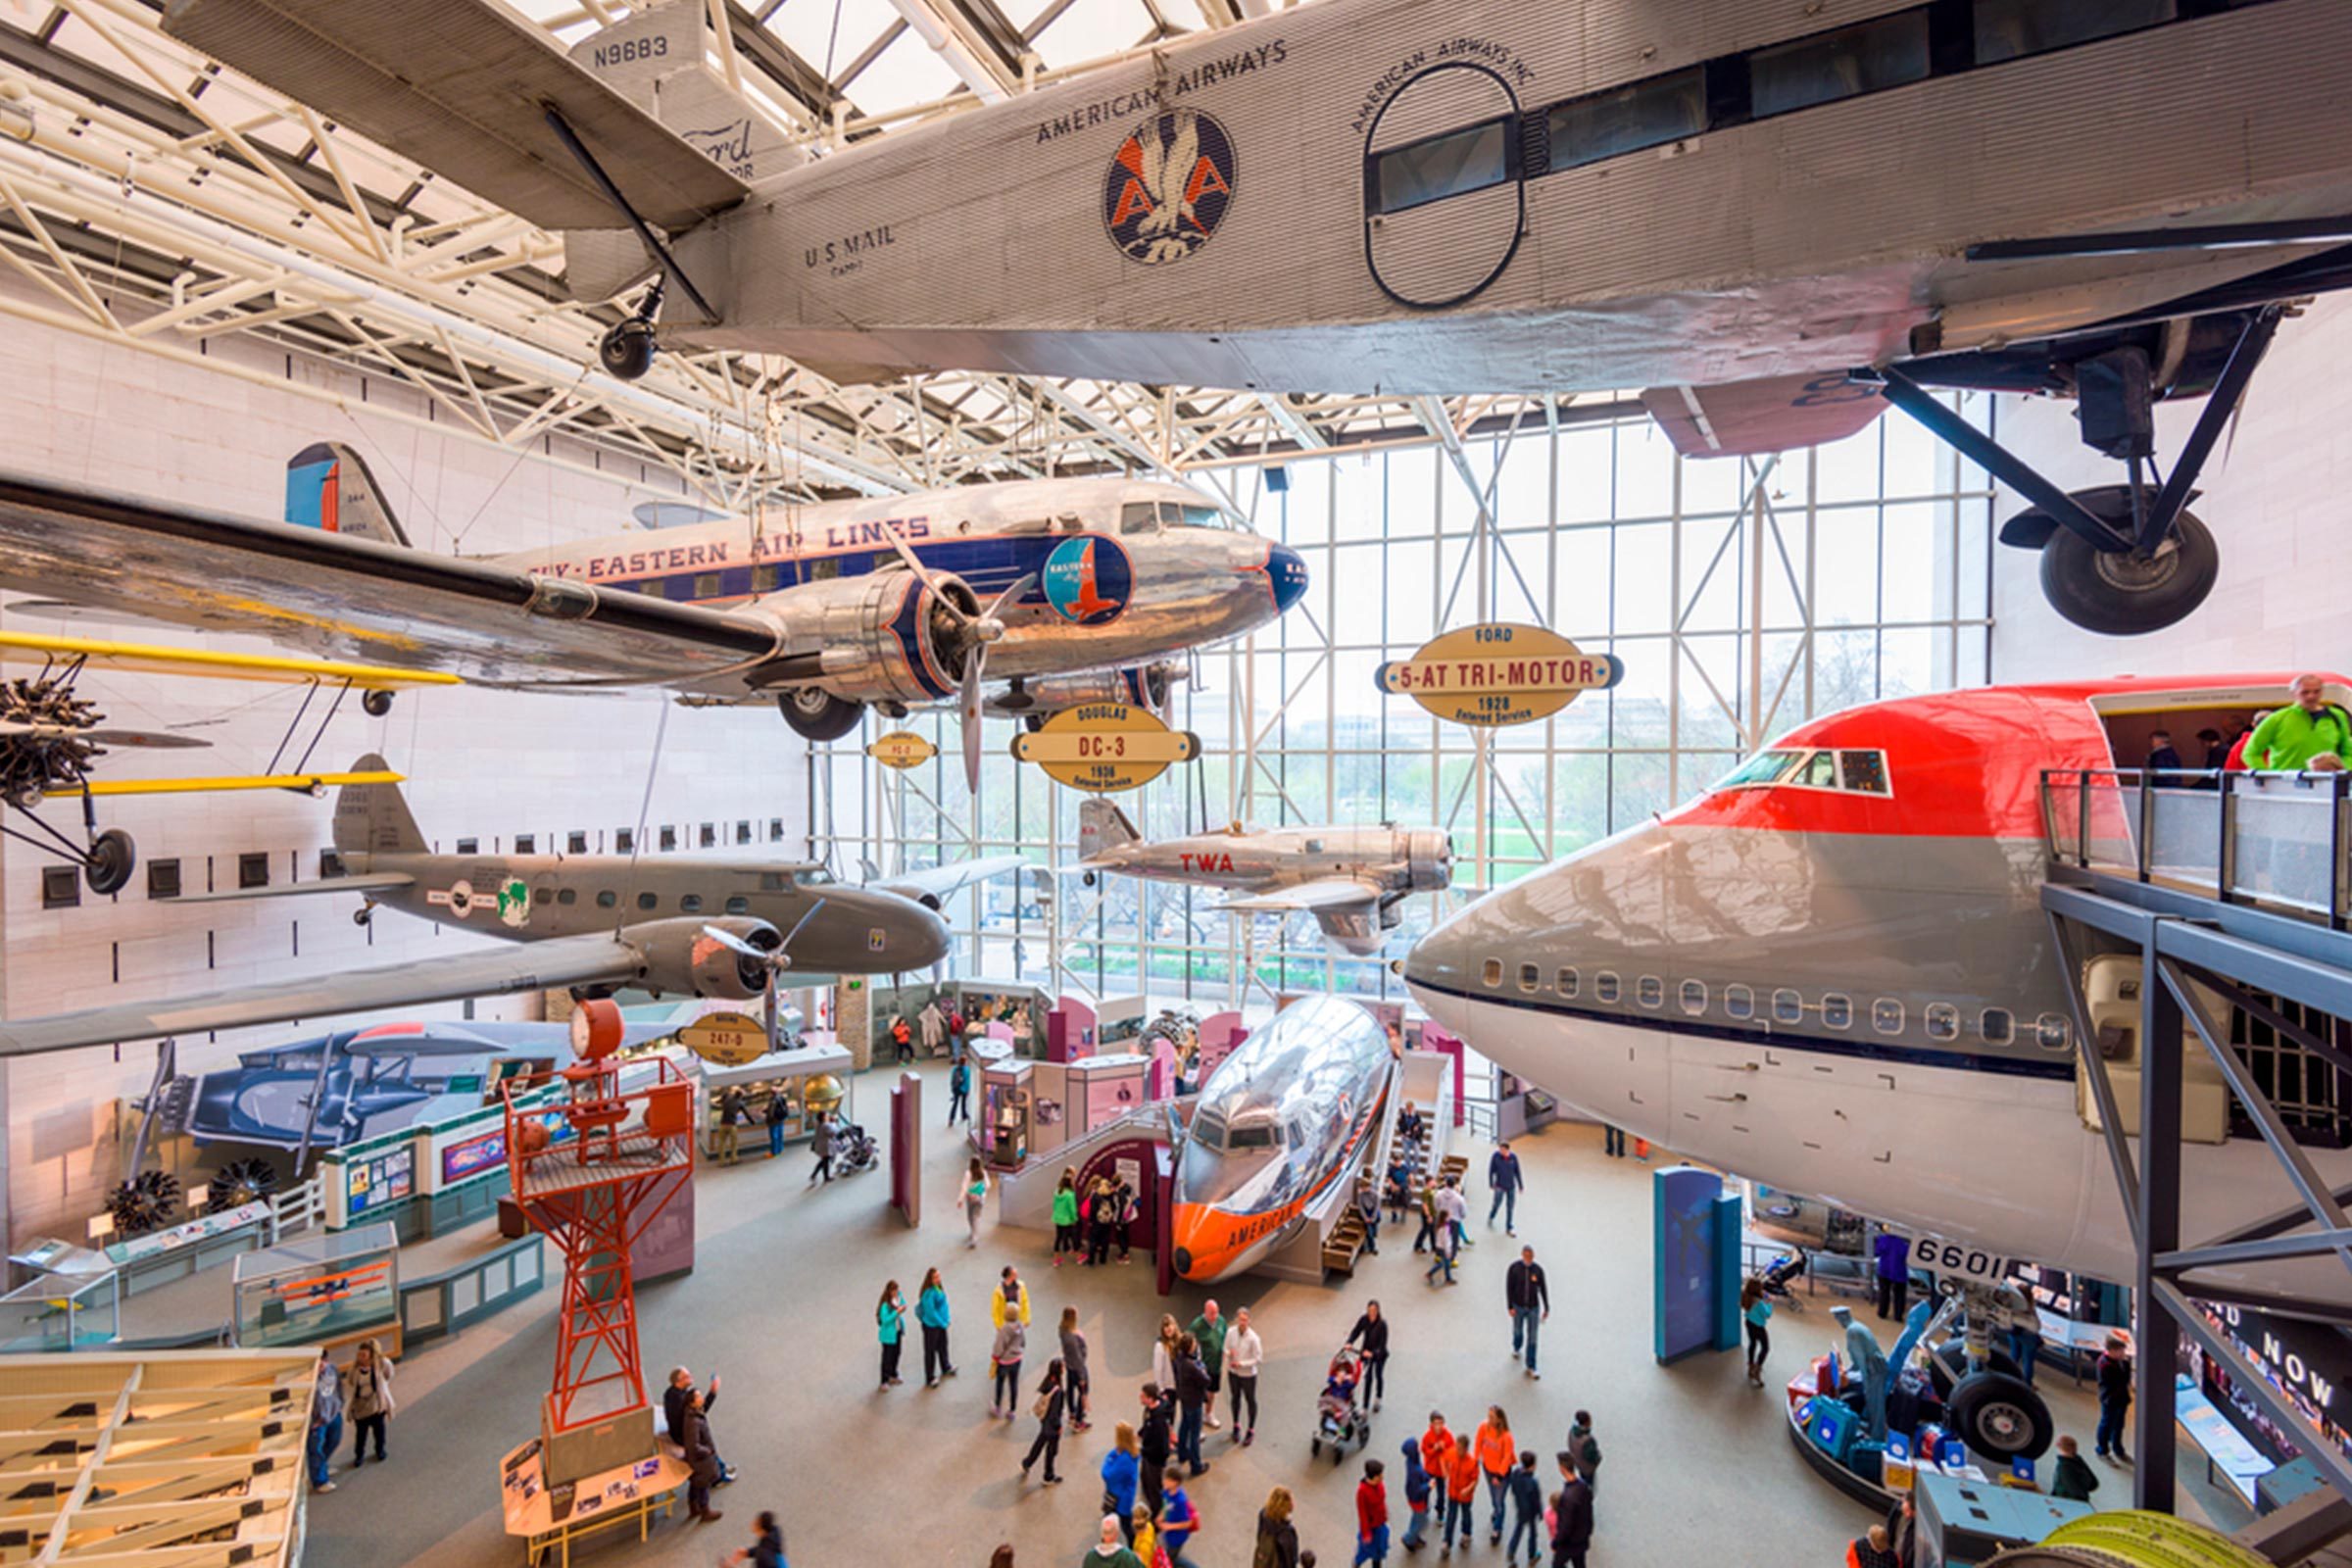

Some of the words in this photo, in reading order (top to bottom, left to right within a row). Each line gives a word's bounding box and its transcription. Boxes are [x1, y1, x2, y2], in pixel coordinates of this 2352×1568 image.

[595, 35, 668, 68] N9683
[1037, 87, 1160, 144] AMERICAN
[1175, 39, 1288, 95] AIRWAYS
[1351, 50, 1425, 134] AMERICAN
[1438, 38, 1512, 65] AIRWAYS
[844, 225, 894, 257] MAIL
[589, 542, 727, 577] EASTERN
[750, 532, 804, 560] AIR
[827, 516, 930, 549] LINES
[1475, 628, 1513, 643] FORD
[1400, 663, 1448, 688] 5-AT
[1458, 660, 1593, 686] TRI-MOTOR
[1077, 705, 1127, 721] DOUGLAS
[1455, 708, 1492, 723] Entered
[1495, 709, 1532, 723] Service
[1479, 696, 1509, 710] 1928
[1079, 737, 1125, 757] DC-3
[1180, 853, 1234, 872] TWA
[1226, 1205, 1294, 1250] AMERICAN
[1917, 1239, 2001, 1279] 6601
[2264, 1331, 2333, 1407] NOW
